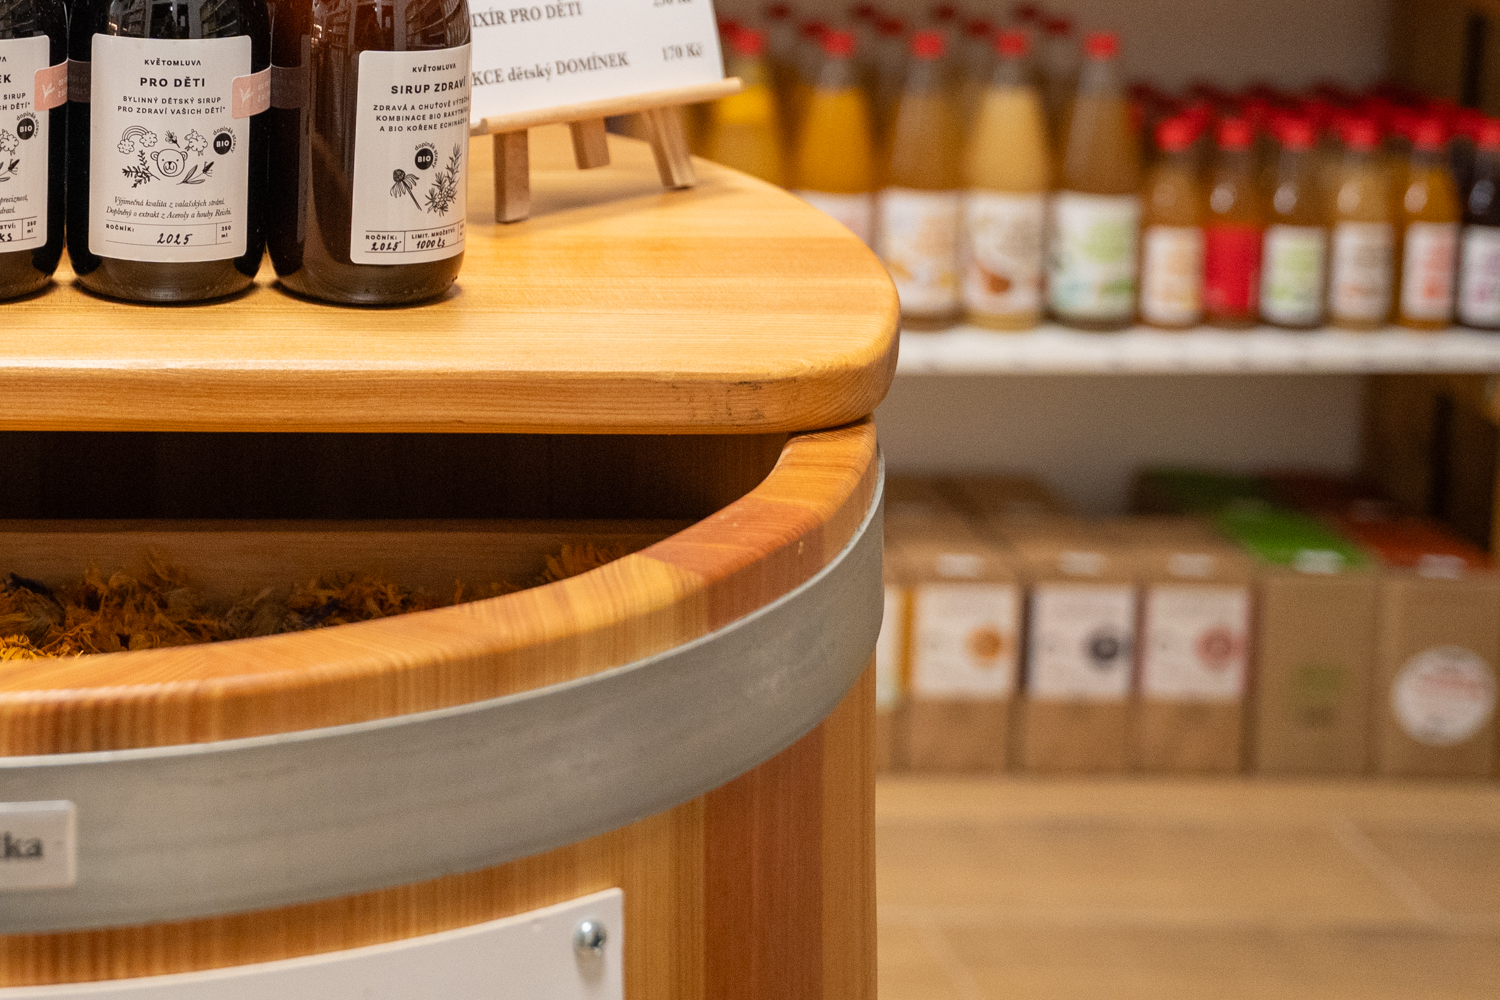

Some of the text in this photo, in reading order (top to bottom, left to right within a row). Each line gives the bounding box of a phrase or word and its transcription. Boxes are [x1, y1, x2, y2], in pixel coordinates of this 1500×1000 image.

[511, 0, 582, 23] PRO DĚTI
[662, 46, 683, 61] 170
[144, 58, 201, 66] KVĚTOMLUVA
[412, 63, 456, 73] KVĚTOMLUVA
[472, 52, 629, 86] KCE dětský DOMÍNEK
[140, 76, 205, 88] PRO DĚTI
[391, 75, 466, 94] SIRUP ZDRAVÍ
[123, 95, 158, 103] BYLINNÝ
[162, 96, 195, 104] DĚTSKÝ
[419, 100, 451, 110] CHUŤOVĚ
[136, 106, 168, 114] ZDRAVÍ
[171, 106, 202, 115] VAŠICH
[19, 125, 33, 133] BIO
[216, 139, 230, 148] BIO
[197, 210, 213, 219] houby
[106, 223, 134, 232] ROČNÍK:
[157, 233, 193, 245] 2025
[371, 240, 402, 251] 2025
